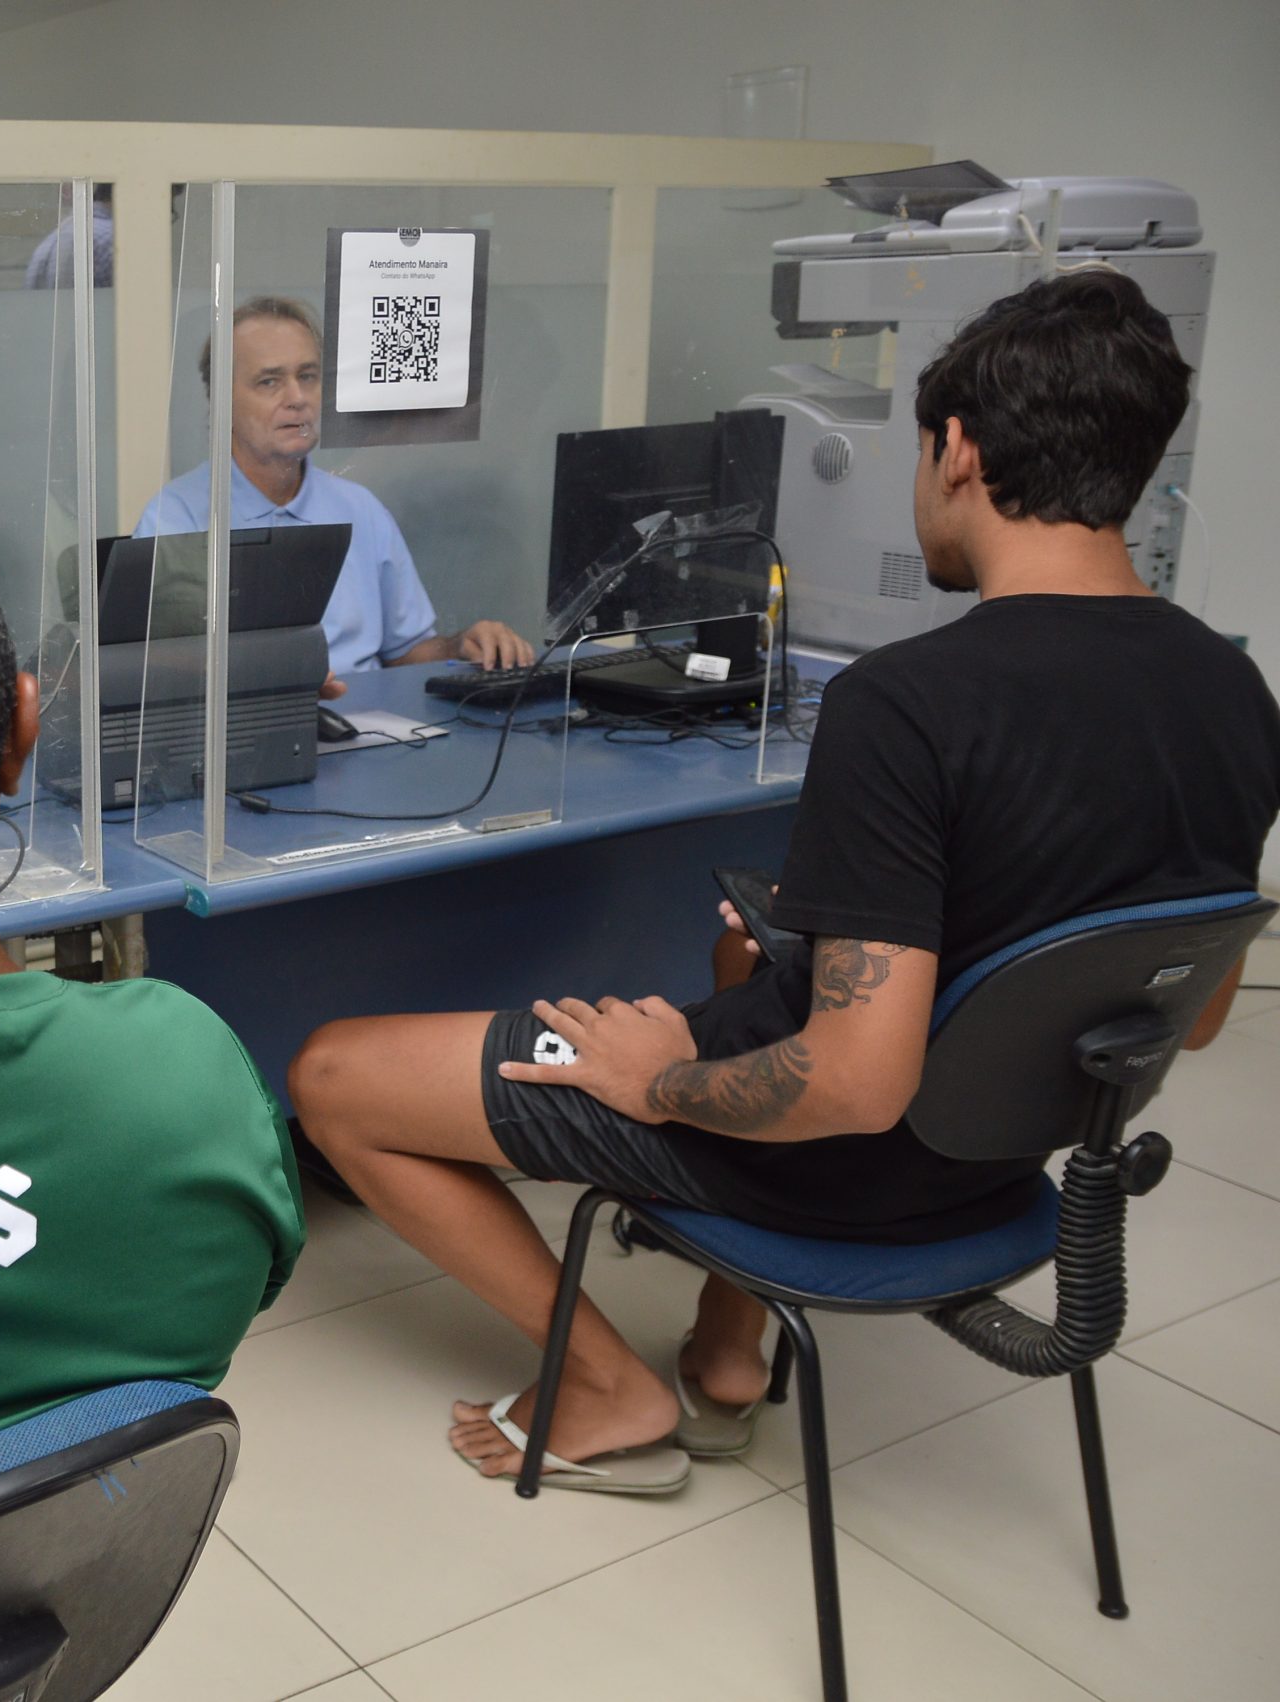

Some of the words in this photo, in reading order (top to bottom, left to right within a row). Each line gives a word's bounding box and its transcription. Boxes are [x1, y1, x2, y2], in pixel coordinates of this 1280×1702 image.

[369, 260, 417, 269] Atendimento
[418, 260, 448, 269] Manaira
[410, 272, 436, 280] WhatsApp
